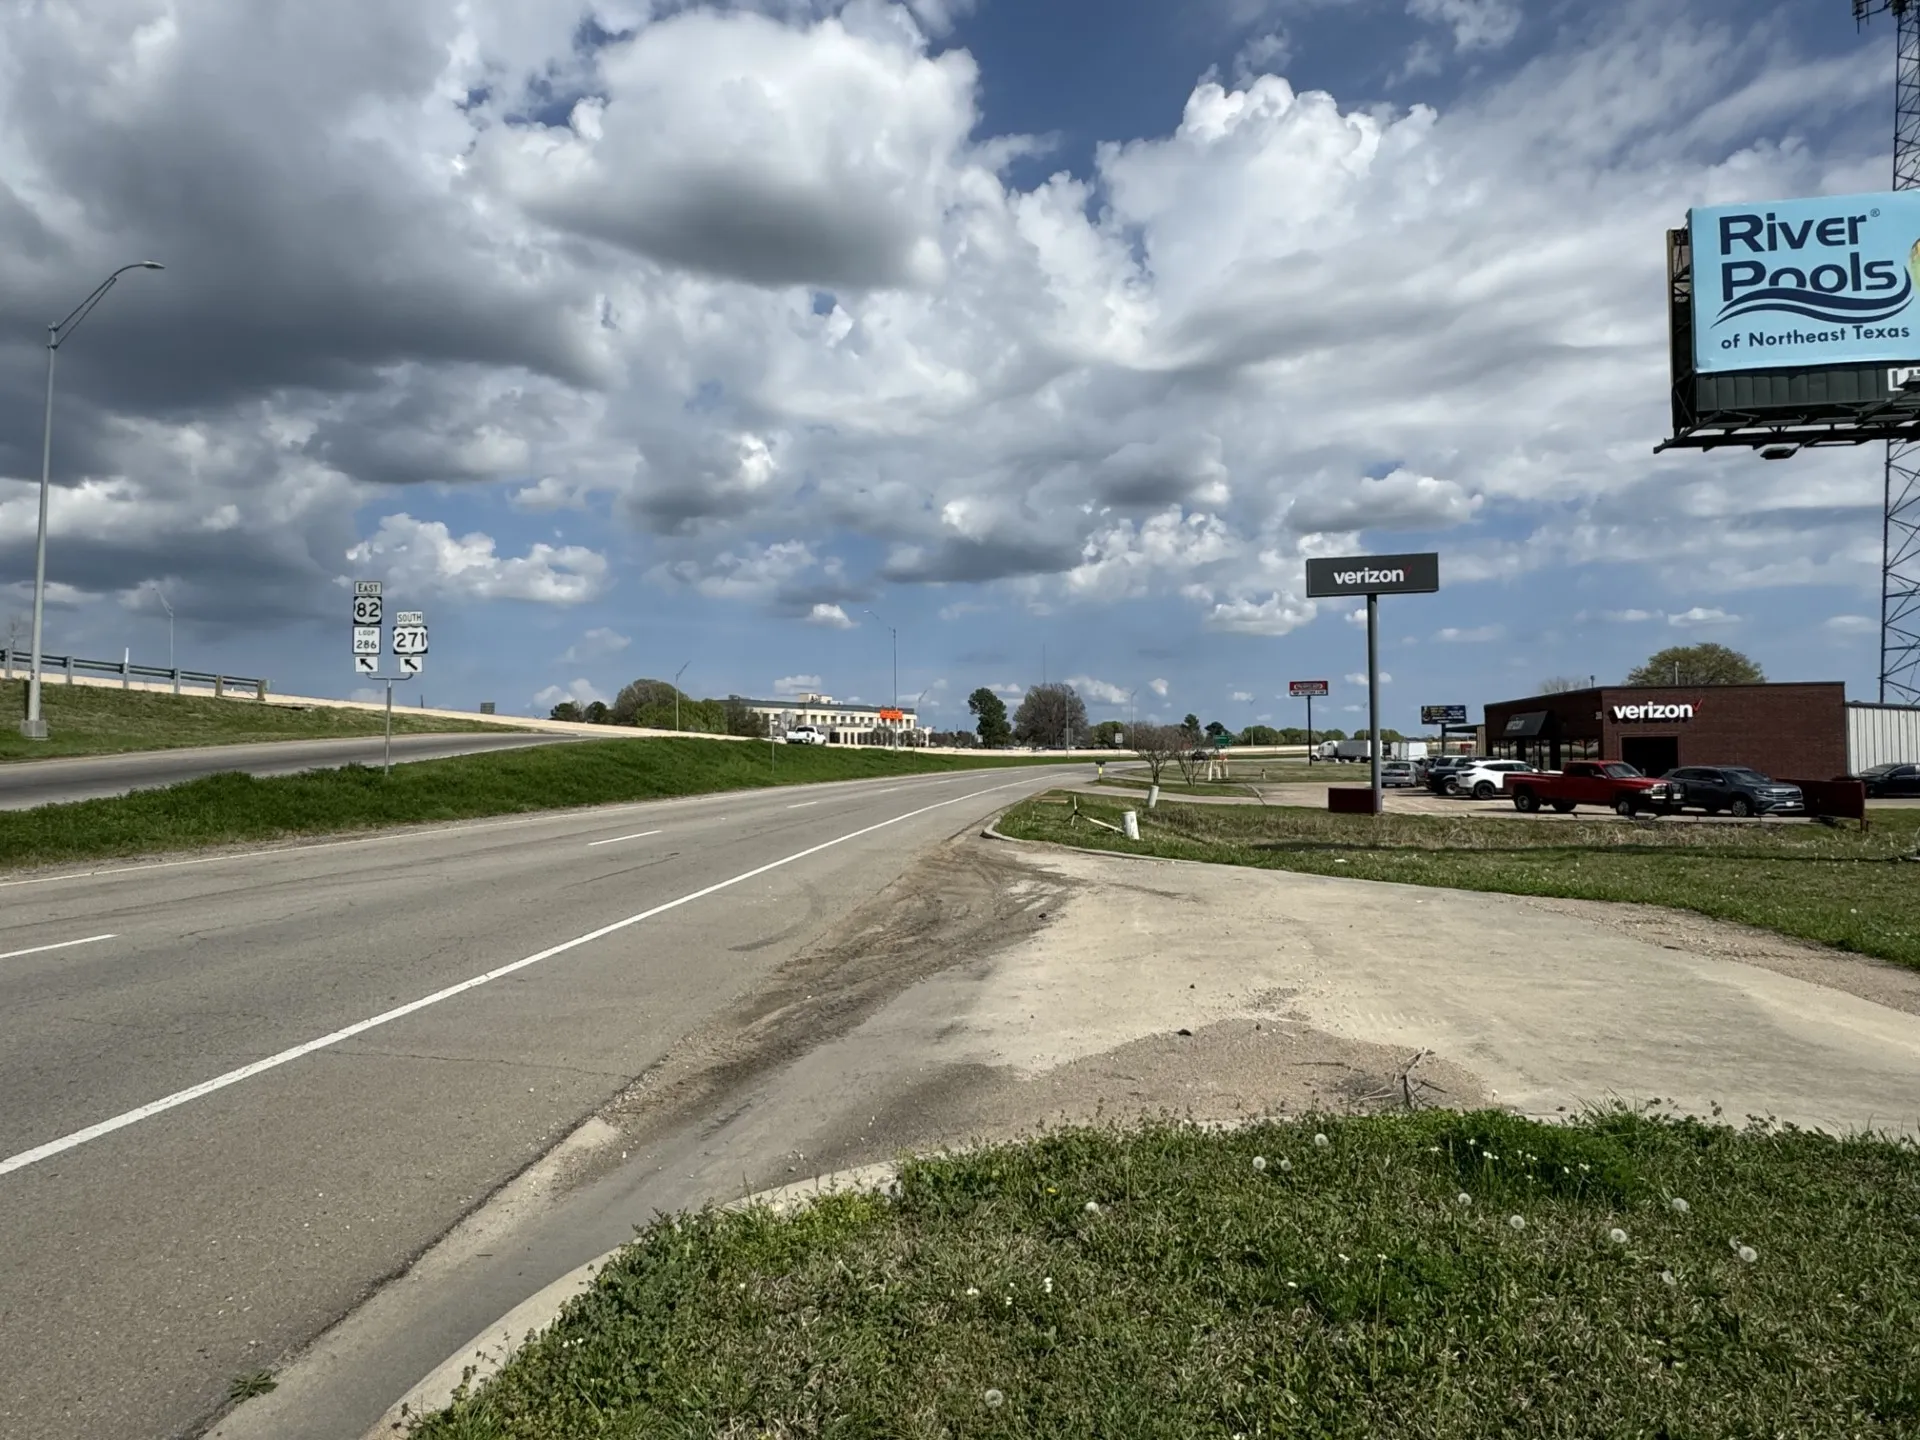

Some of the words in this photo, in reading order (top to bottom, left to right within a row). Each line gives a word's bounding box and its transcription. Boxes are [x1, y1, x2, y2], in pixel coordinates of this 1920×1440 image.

[1719, 212, 1867, 255] River
[1721, 252, 1897, 302] Pools
[1721, 333, 1741, 350] of
[1749, 329, 1846, 347] Northeast
[1852, 325, 1910, 340] Texas
[1333, 567, 1404, 584] verizon
[358, 583, 378, 592] EAST
[356, 602, 379, 617] 82
[398, 614, 422, 622] SOUTH
[356, 640, 377, 649] 286
[396, 632, 425, 648] 271
[1613, 701, 1693, 719] verizon
